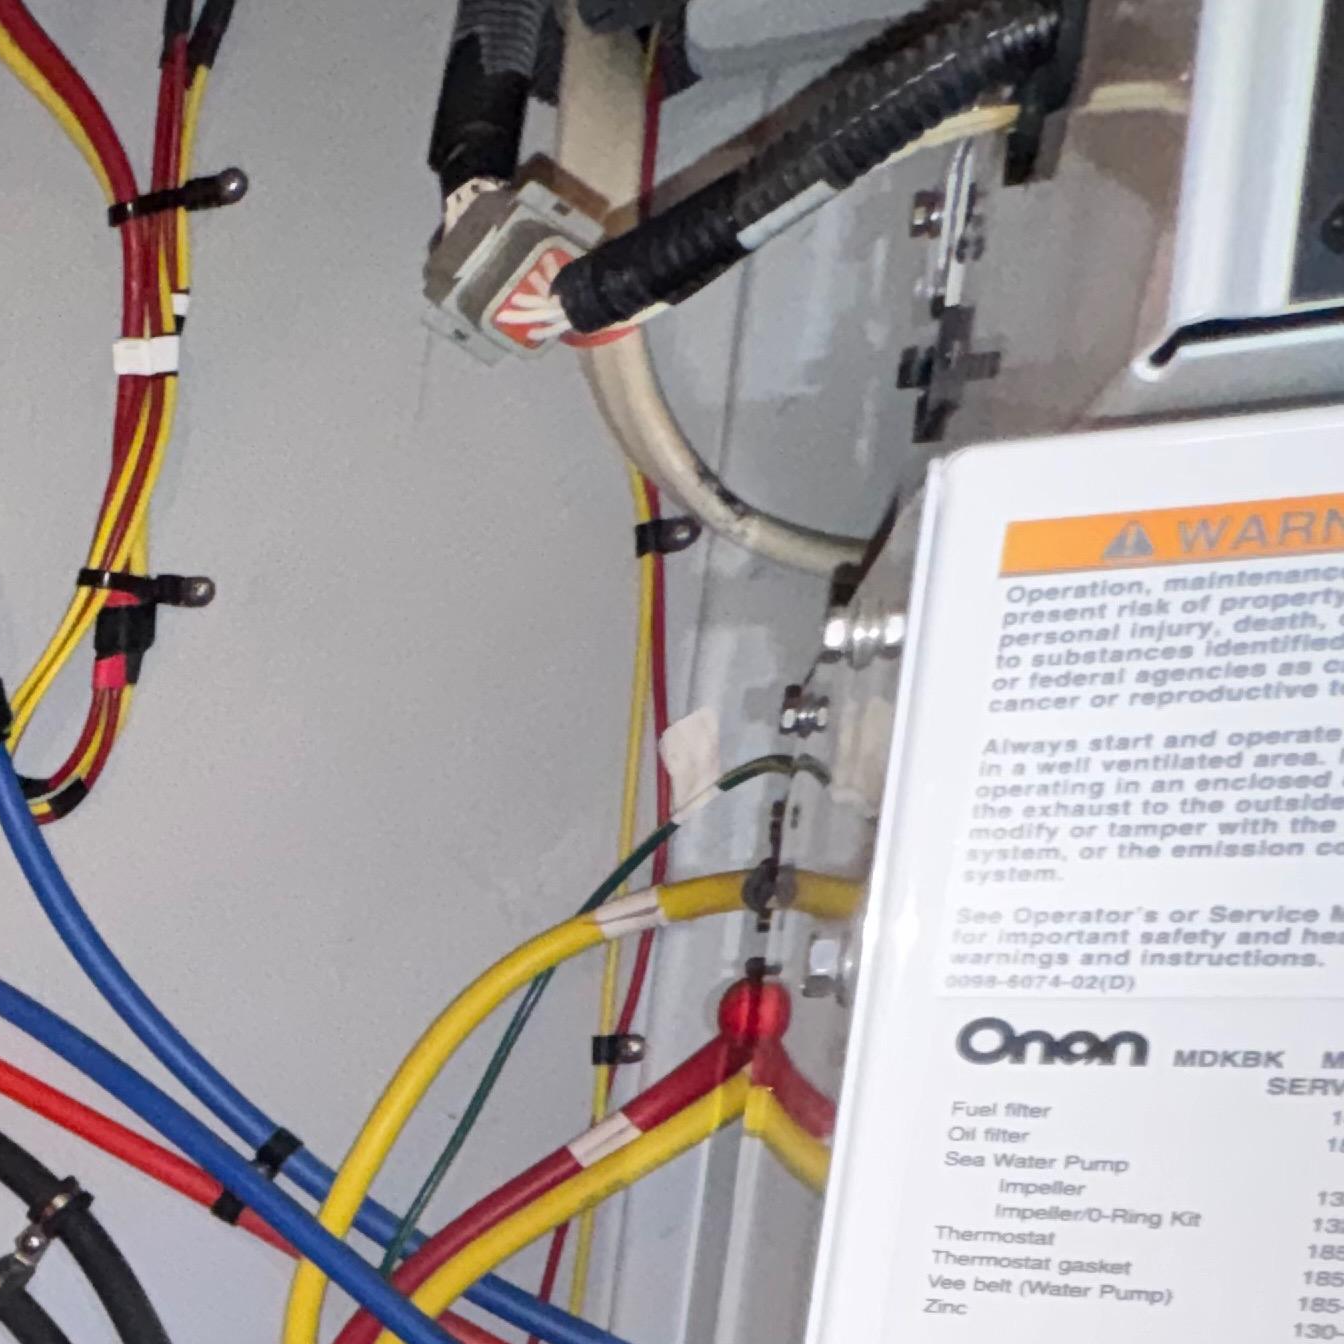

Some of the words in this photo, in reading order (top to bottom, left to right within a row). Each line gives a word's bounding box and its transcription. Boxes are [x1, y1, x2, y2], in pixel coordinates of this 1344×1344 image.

[1007, 580, 1152, 606] Operation,
[1003, 603, 1107, 628] present
[1117, 599, 1171, 618] risk
[1182, 596, 1211, 614] of
[999, 623, 1120, 651] personal
[996, 653, 1020, 669] to
[1032, 644, 1194, 668] substances
[992, 675, 1019, 691] or
[1029, 667, 1126, 688] federal
[1136, 661, 1267, 687] agencies
[1277, 659, 1312, 675] as
[989, 694, 1080, 713] cancer
[1090, 692, 1120, 708] or
[1130, 681, 1318, 709] reproductive
[983, 739, 1078, 758] Always
[1089, 735, 1153, 753] start
[1164, 731, 1218, 748] and
[1227, 726, 1342, 748] operate
[1038, 757, 1092, 774] well
[1102, 752, 1244, 773] ventilated
[975, 780, 1105, 801] operating
[1151, 777, 1185, 793] an
[1195, 771, 1333, 791] enclosed
[972, 803, 1012, 819] the
[1022, 800, 1132, 818] exhaust
[1142, 799, 1169, 816] to
[1180, 797, 1225, 814] the
[969, 821, 1059, 845] modify
[1070, 822, 1098, 838] or
[1108, 820, 1208, 841] tamper
[1218, 817, 1279, 835] with
[1291, 816, 1337, 834] the
[1079, 844, 1107, 861] or
[1118, 842, 1161, 858] the
[1171, 840, 1305, 858] emission
[956, 907, 1003, 924] See
[1169, 907, 1199, 923] or
[1209, 905, 1320, 924] Service
[952, 929, 987, 945] for
[998, 929, 1129, 949] important
[1140, 928, 1226, 949] safety
[1236, 927, 1291, 945] and
[950, 951, 1070, 969] warnings
[1080, 949, 1131, 966] and
[1173, 1049, 1286, 1069] MDKBK
[951, 1101, 997, 1118] Fuel
[1005, 1103, 1051, 1118] filter
[948, 1126, 976, 1142] Oil
[984, 1128, 1029, 1143] filter
[944, 1151, 985, 1167] Sea
[994, 1152, 1056, 1170] Water
[1064, 1155, 1129, 1175] Pump
[1170, 1211, 1202, 1228] Kit
[935, 1225, 1055, 1247] Thermostat
[932, 1249, 1051, 1272] Thermostat
[1058, 1259, 1133, 1278] gasket
[928, 1274, 966, 1291] Vee
[973, 1277, 1012, 1294] belt
[1019, 1279, 1091, 1300] (Water
[1099, 1284, 1174, 1306] Pump)
[923, 1298, 968, 1316] Zinc
